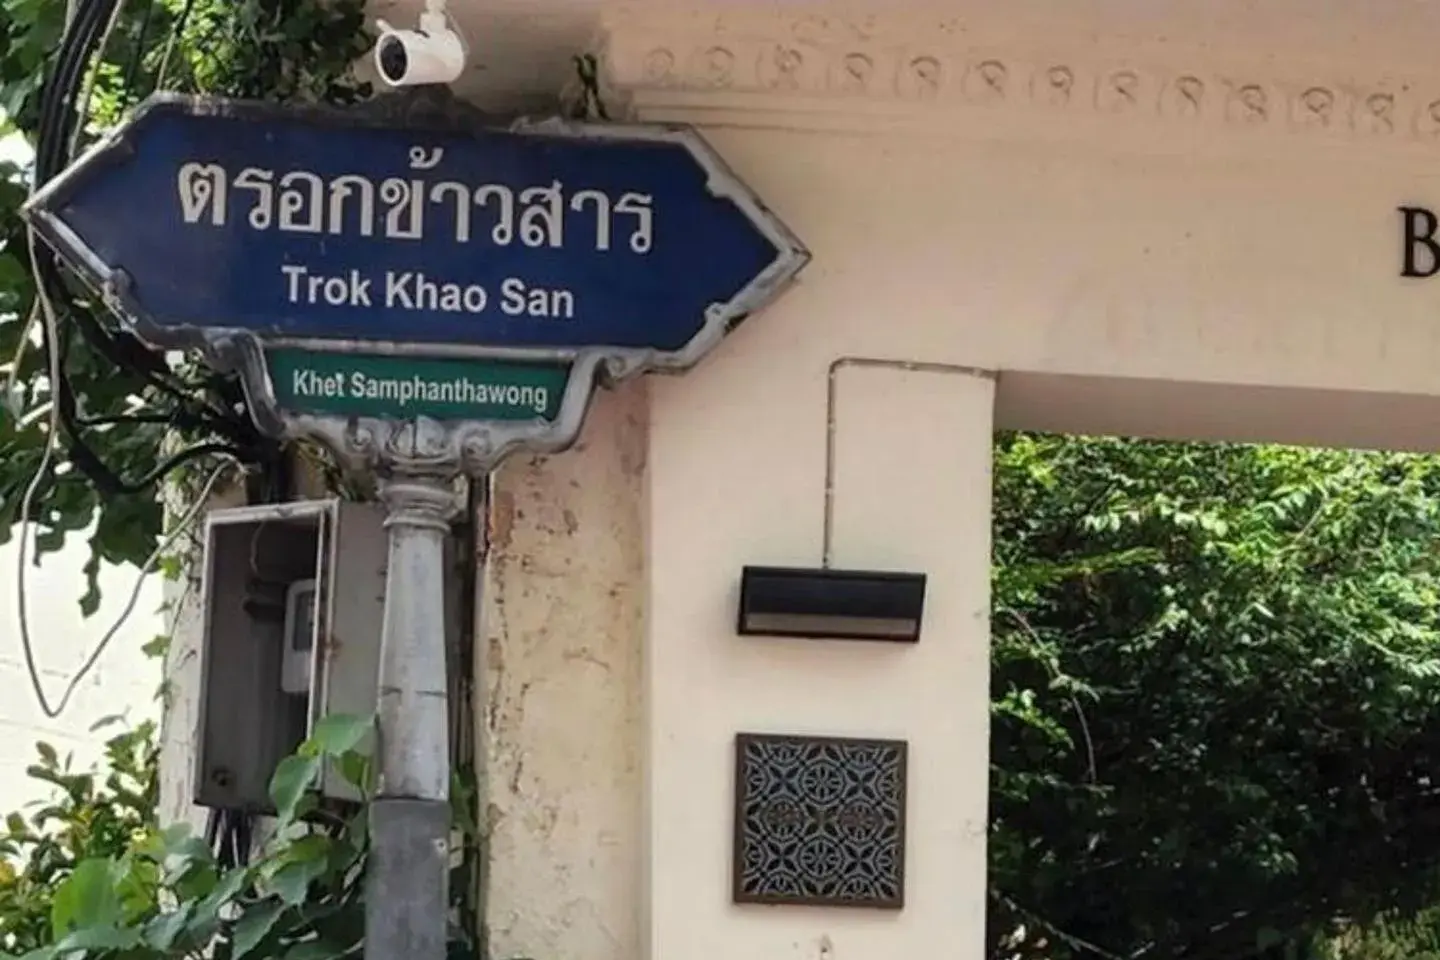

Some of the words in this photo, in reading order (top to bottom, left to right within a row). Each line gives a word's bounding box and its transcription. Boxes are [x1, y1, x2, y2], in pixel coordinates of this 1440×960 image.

[177, 146, 653, 254] ตรอกข้าวสาร
[281, 265, 372, 307] Trok
[385, 271, 488, 313] Khao
[500, 278, 574, 318] San
[293, 369, 346, 398] Khet
[350, 371, 547, 412] Samphanthawong
